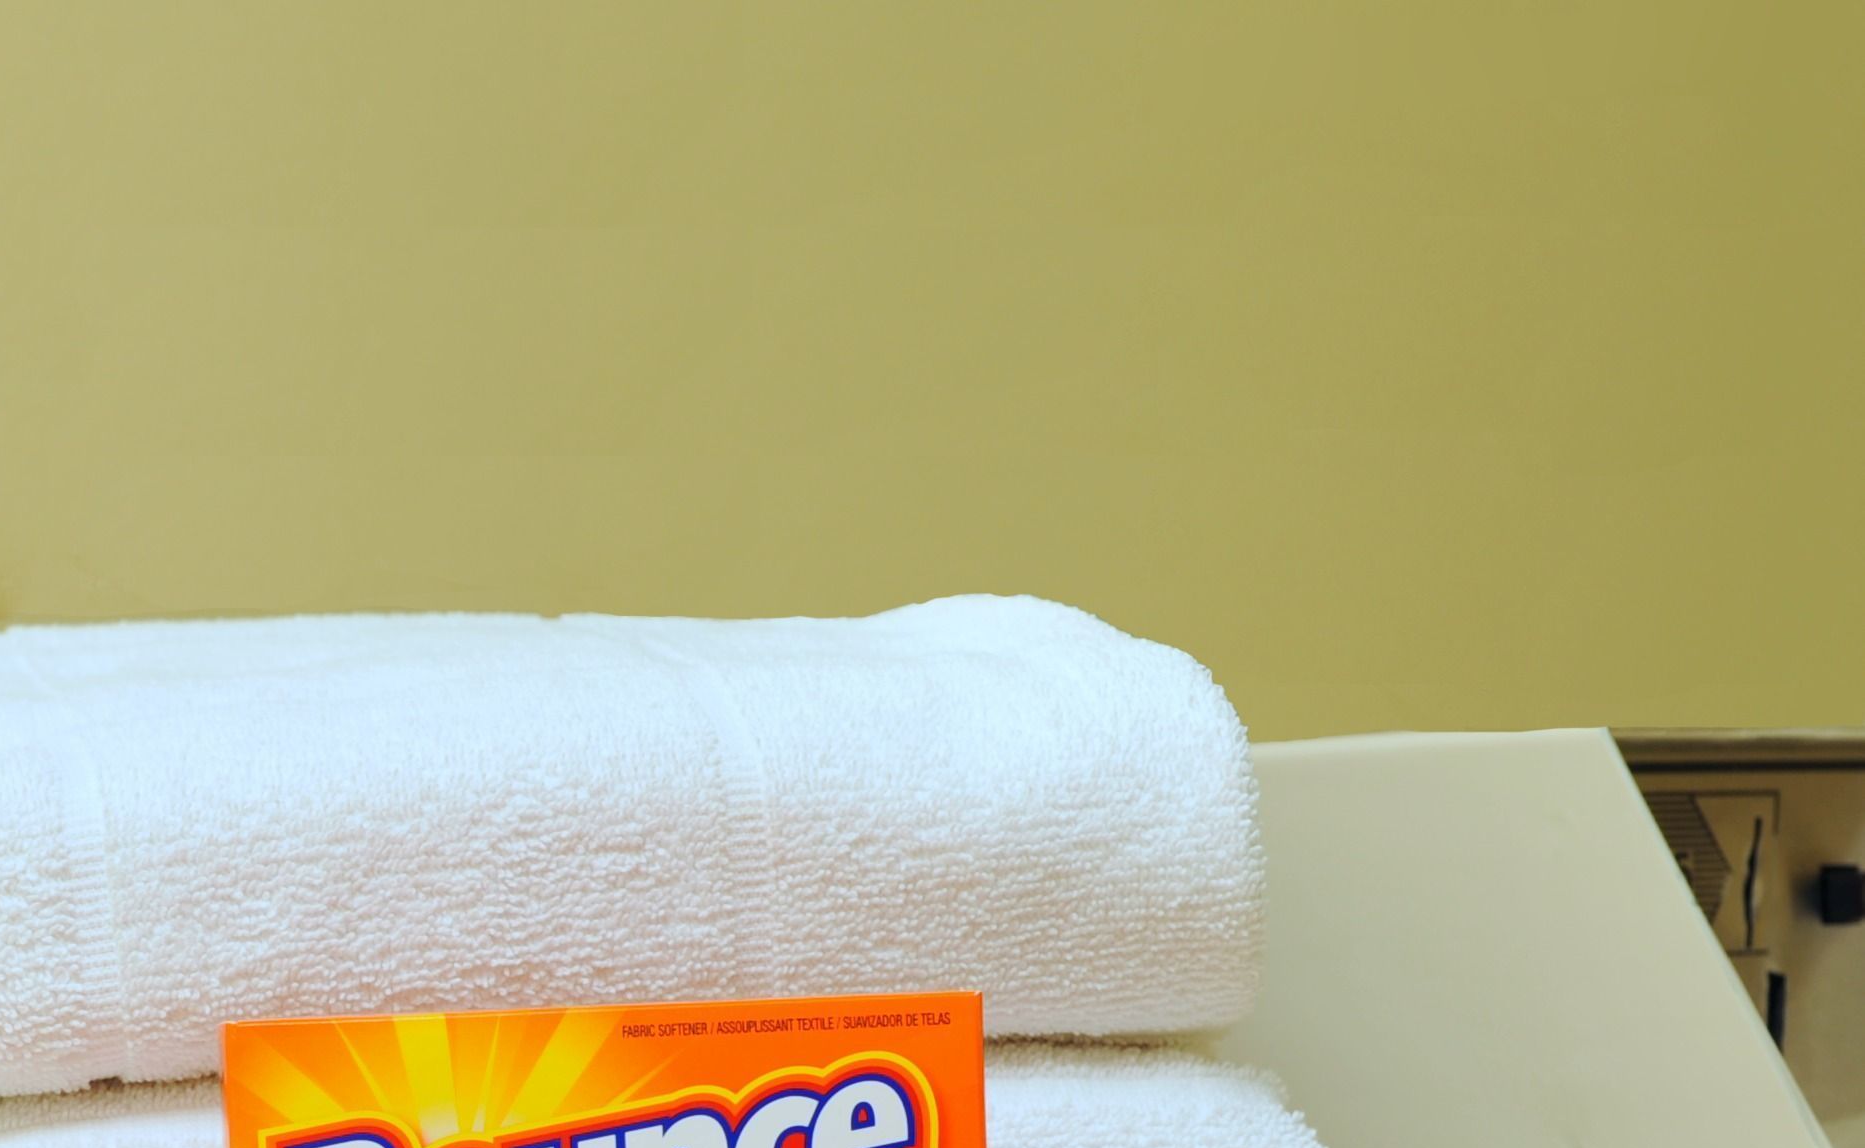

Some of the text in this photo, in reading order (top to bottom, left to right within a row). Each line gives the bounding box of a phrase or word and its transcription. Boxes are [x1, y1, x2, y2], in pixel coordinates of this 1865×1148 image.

[622, 1012, 950, 1038] FABRIC SOFTENER ASSOUPLISSANT TEXTILE SUAVIZADOR DE TELAS
